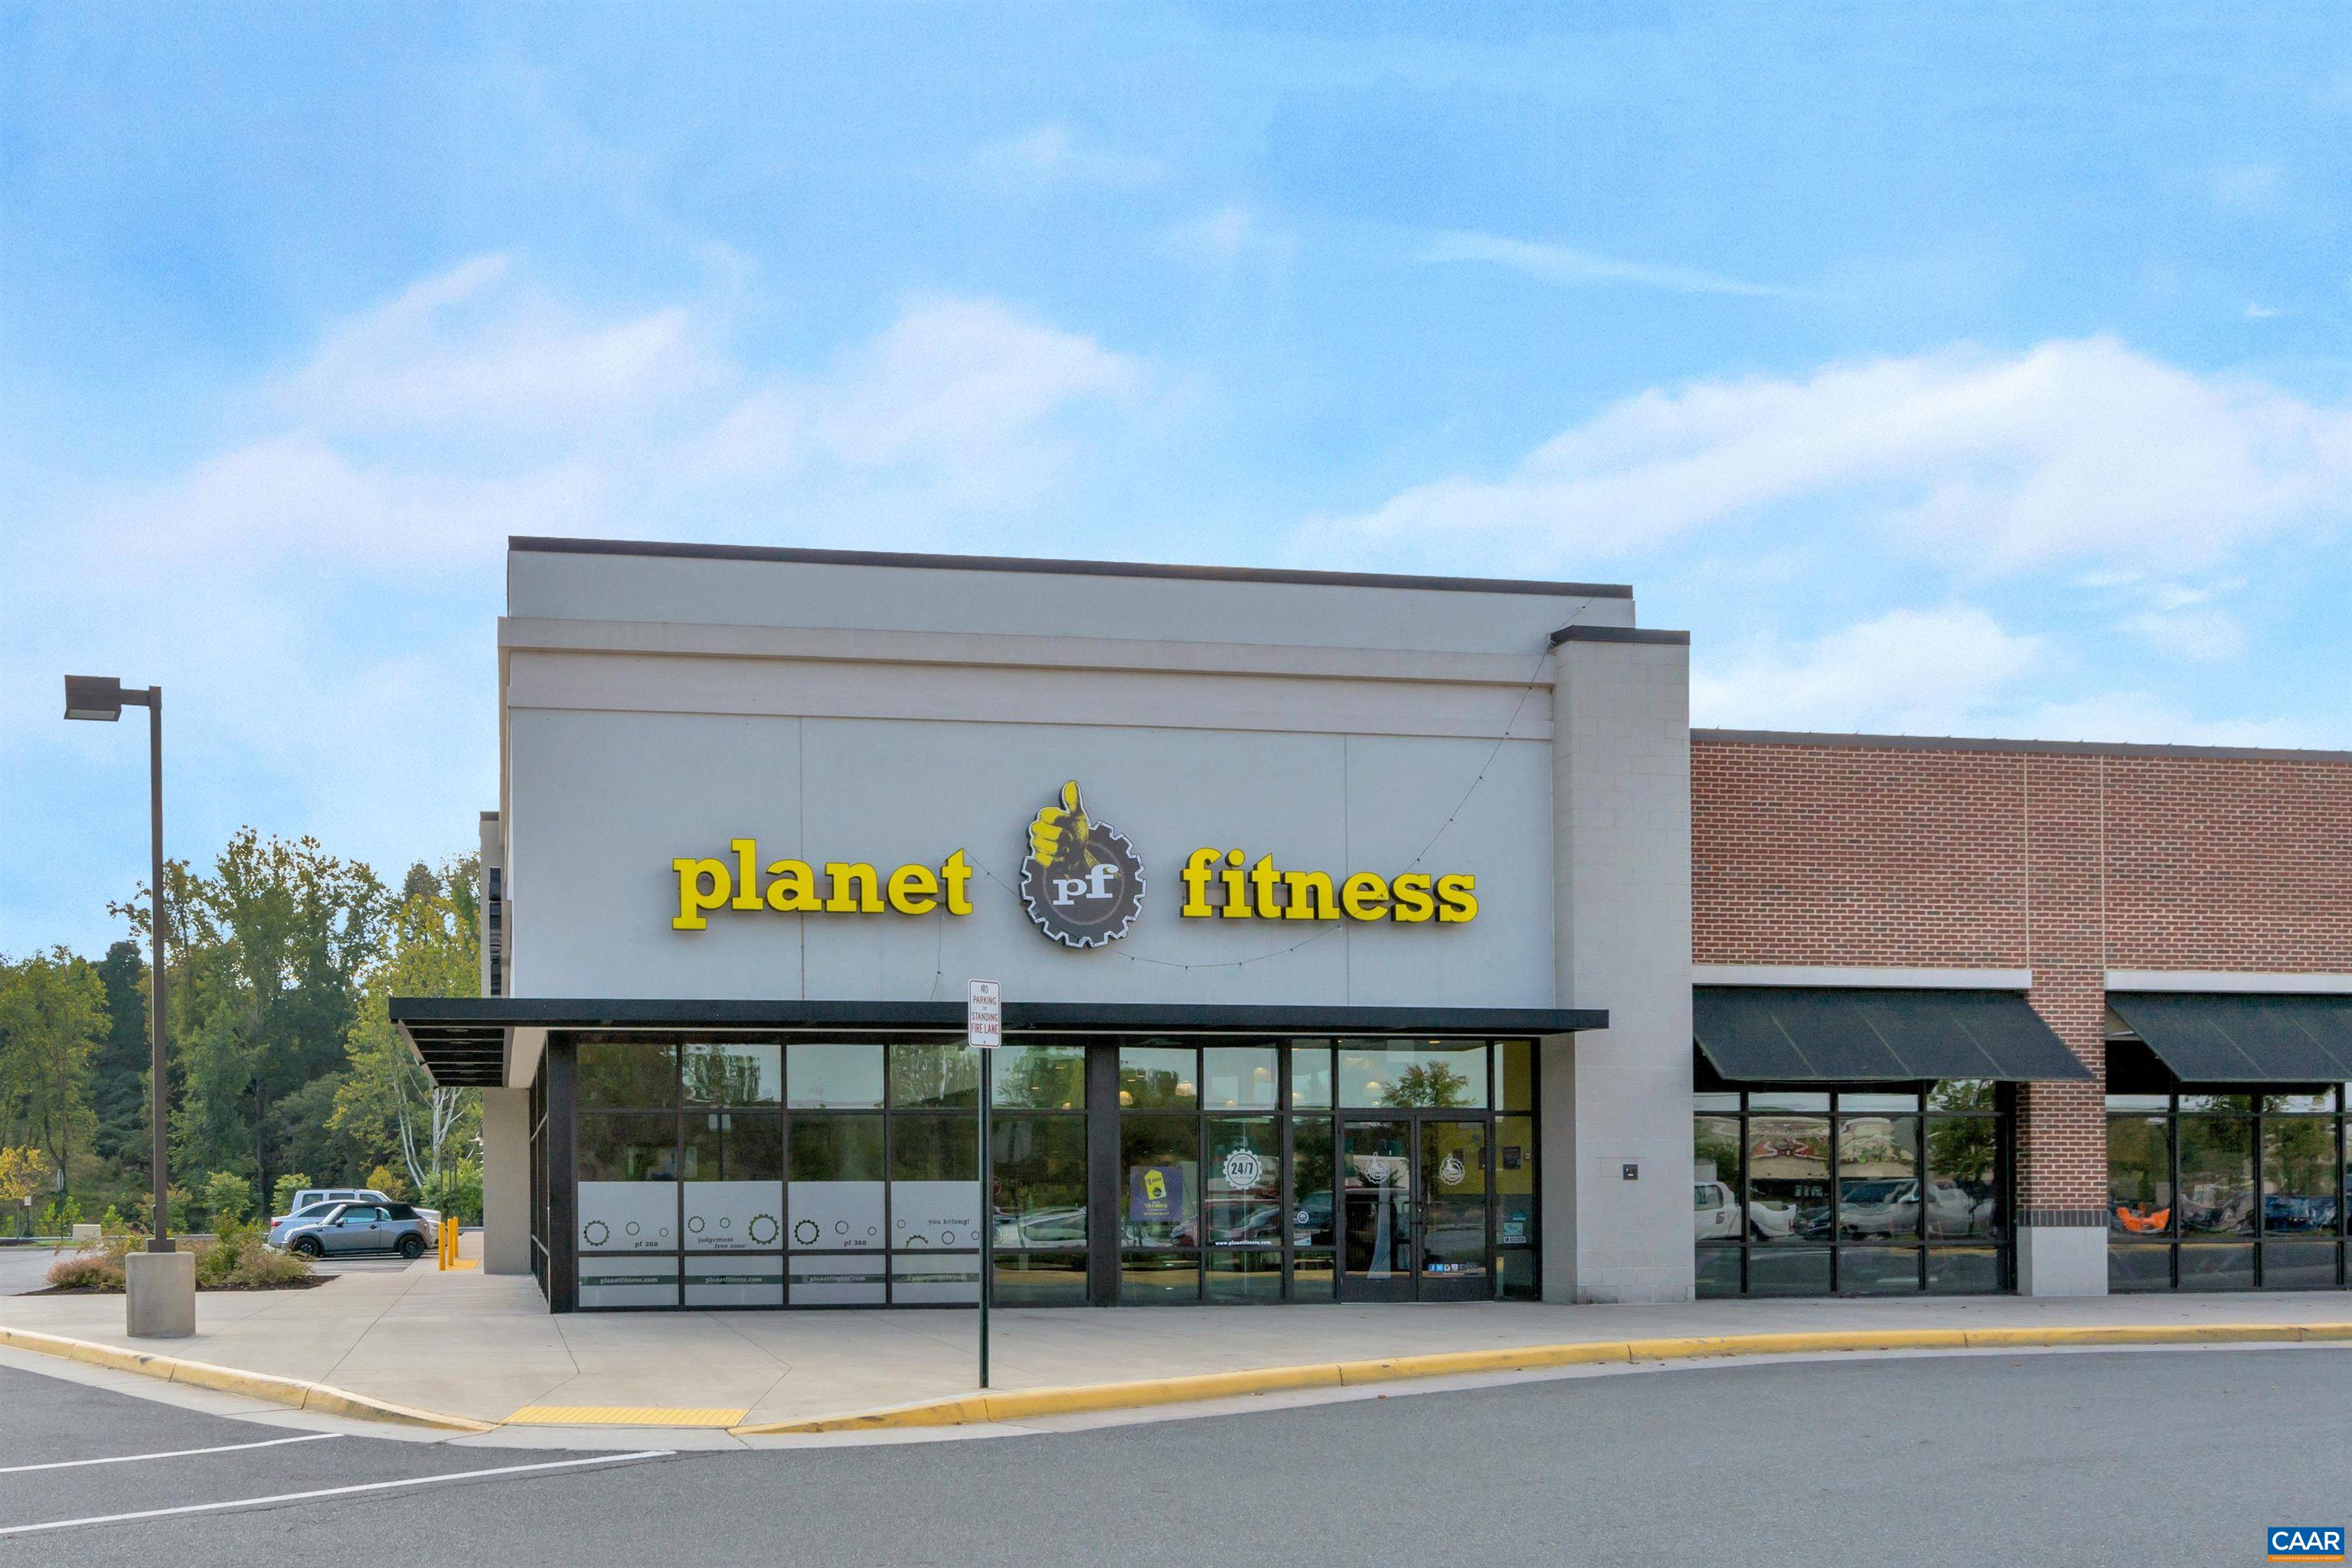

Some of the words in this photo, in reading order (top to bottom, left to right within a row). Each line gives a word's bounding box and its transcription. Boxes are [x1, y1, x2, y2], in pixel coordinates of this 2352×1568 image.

[672, 838, 973, 930] planet
[1180, 848, 1478, 923] fitness
[1053, 864, 1119, 905] pf
[981, 984, 988, 994] NO
[972, 995, 996, 1005] PARKING
[972, 1012, 998, 1022] STANDING
[971, 1023, 982, 1034] FIRE
[985, 1024, 998, 1034] LANE
[1231, 1162, 1253, 1174] 24/7
